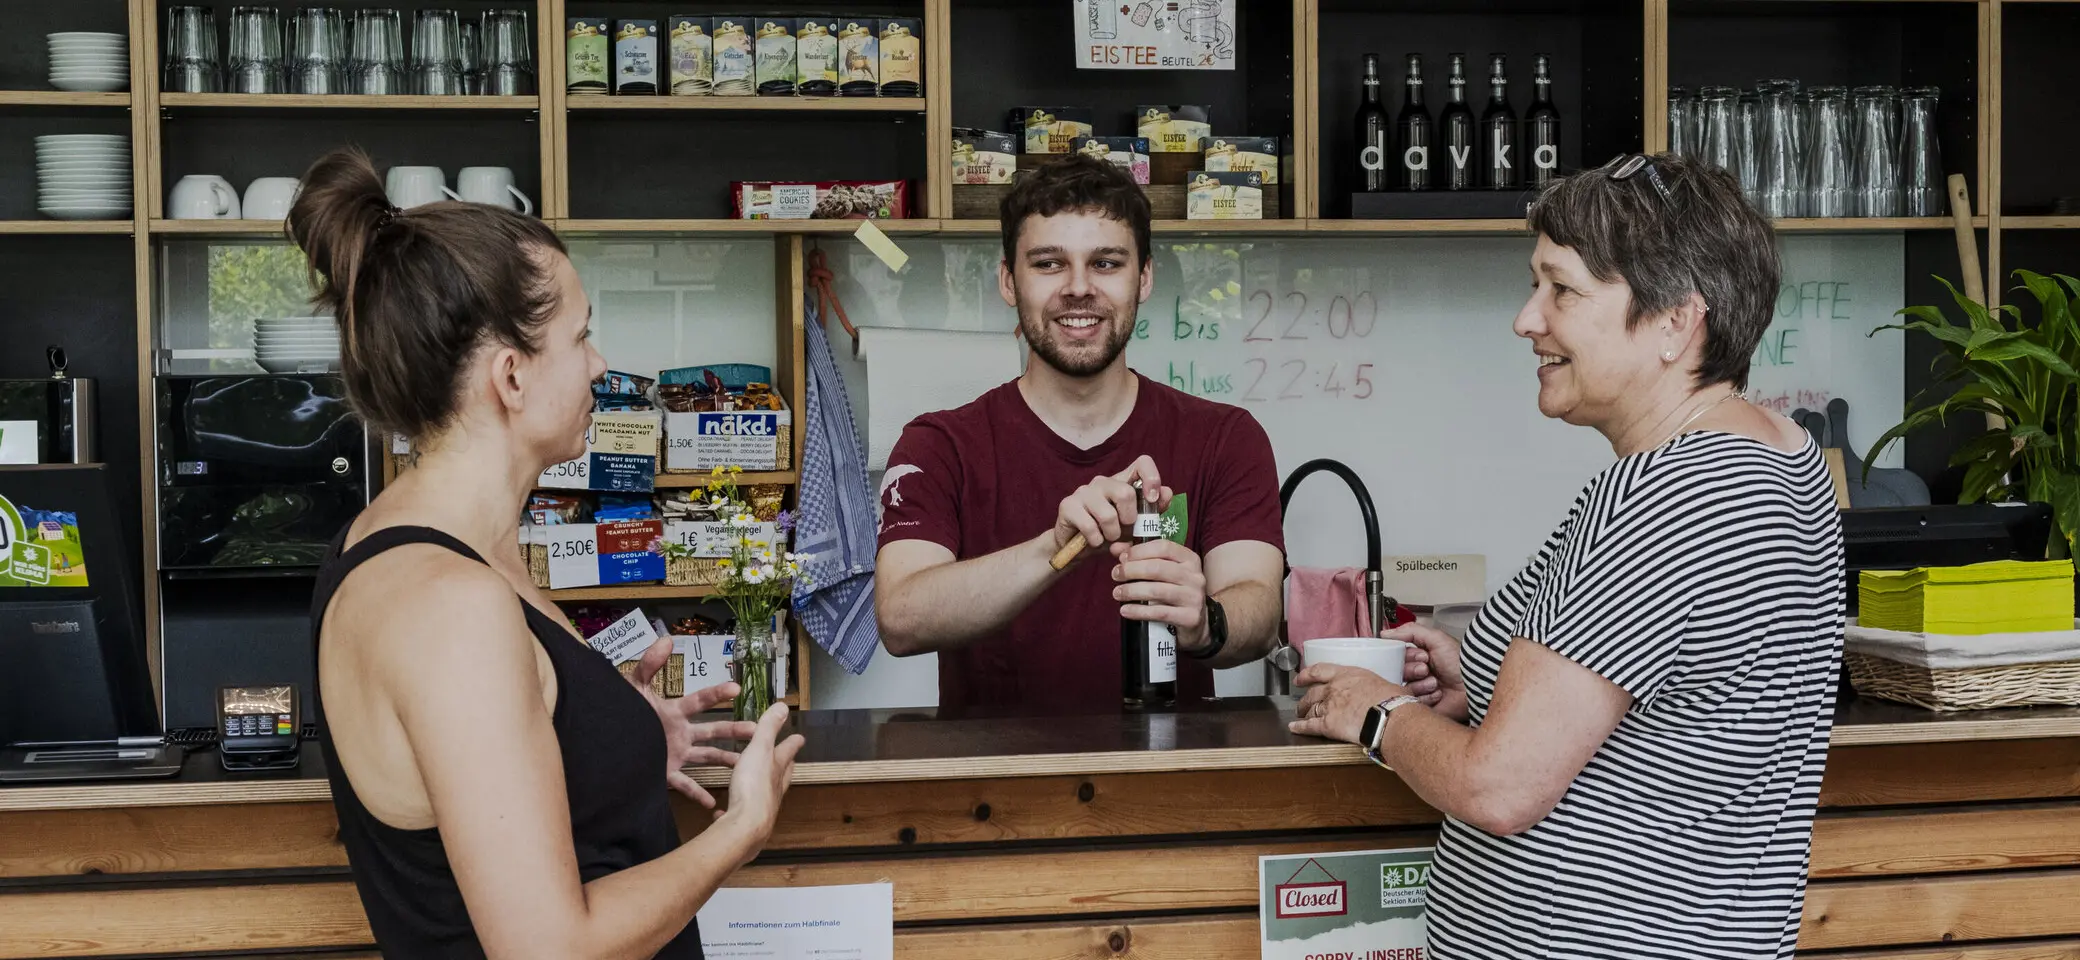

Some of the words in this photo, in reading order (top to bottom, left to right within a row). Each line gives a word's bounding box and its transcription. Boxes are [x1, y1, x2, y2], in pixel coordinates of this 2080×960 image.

[1091, 45, 1157, 65] EISTEE
[1162, 56, 1194, 66] BEUTEL
[1198, 54, 1214, 66] 2€
[1162, 134, 1186, 142] EISTEE
[967, 165, 990, 174] EISTEE
[779, 195, 810, 204] COOKIES
[1213, 199, 1237, 208] EISTEE
[1778, 281, 1851, 319] OFFE
[1174, 295, 1219, 341] bis
[1243, 289, 1378, 342] 22:00
[1242, 357, 1374, 401] 22:45
[669, 439, 693, 448] 1,50€
[543, 461, 587, 478] 2,50€
[680, 531, 698, 547] 1€
[551, 539, 595, 559] 2,50€
[1396, 560, 1458, 573] Spülbecken
[689, 661, 708, 677] 1€
[1404, 866, 1430, 885] DA
[1285, 889, 1338, 908] Closed
[728, 921, 783, 929] Informationen
[802, 920, 841, 928] Halbfinale
[1366, 947, 1424, 960] UNSERE
